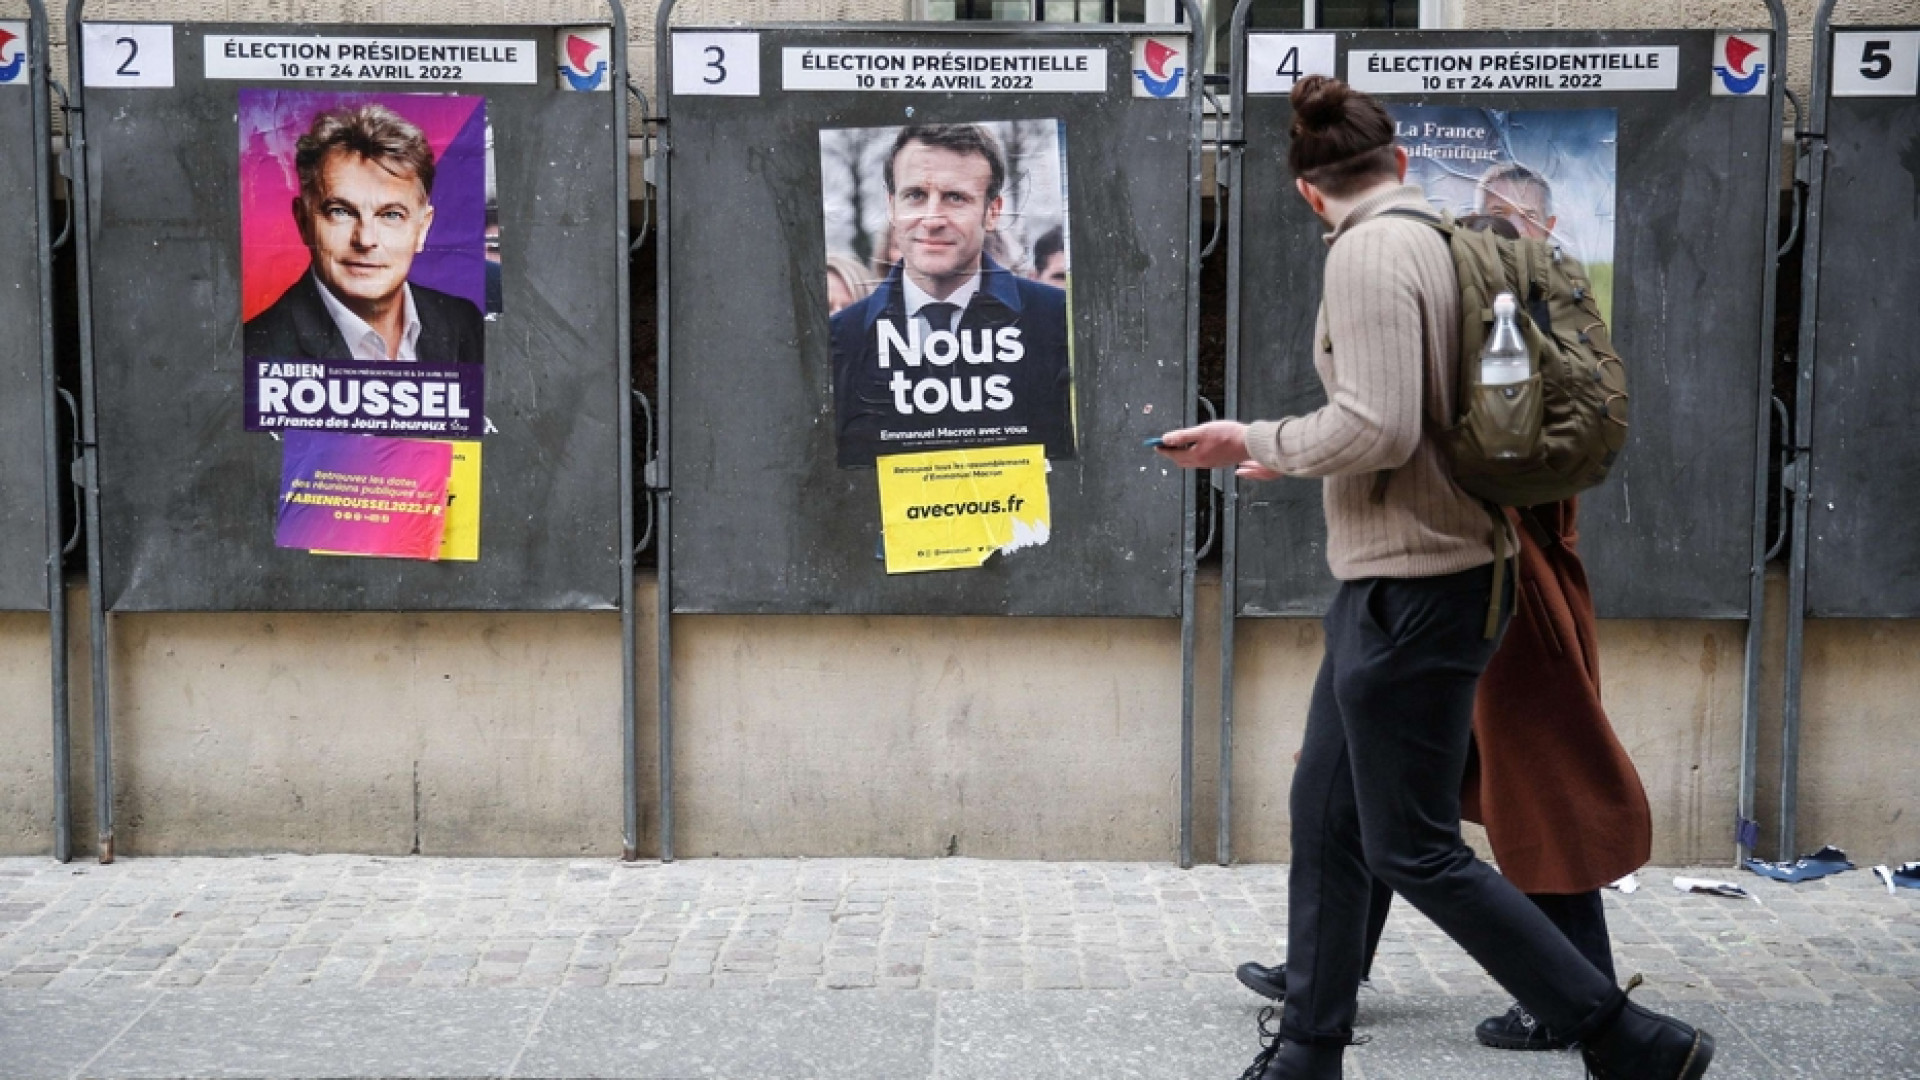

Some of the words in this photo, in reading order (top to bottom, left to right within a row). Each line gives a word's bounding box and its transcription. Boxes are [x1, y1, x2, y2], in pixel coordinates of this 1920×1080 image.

[115, 37, 141, 78] 2
[223, 39, 331, 59] ÉLECTION
[338, 41, 518, 63] PRÉSIDENTIELLE
[801, 50, 905, 71] ÉLECTION
[912, 51, 1088, 71] PRÉSIDENTIELLE
[1367, 53, 1473, 72] ÉLECTION
[1479, 51, 1660, 71] PRÉSIDENTIELLE
[1859, 40, 1892, 79] 5
[280, 63, 300, 77] 10
[305, 65, 325, 77] ET
[330, 64, 353, 78] 24
[357, 65, 414, 79] AVRIL
[419, 65, 463, 80] 2022
[702, 45, 727, 84] 3
[1276, 46, 1303, 83] 4
[855, 74, 875, 88] 10
[880, 77, 900, 88] ET
[904, 75, 927, 89] 24
[931, 75, 986, 89] AVRIL
[991, 75, 1034, 89] 2022
[1421, 75, 1441, 89] 10
[1446, 77, 1466, 89] ET
[1470, 75, 1494, 89] 24
[1498, 75, 1553, 89] AVRIL
[1559, 74, 1602, 88] 2022
[1394, 121, 1418, 136] La
[1423, 121, 1486, 138] France
[1406, 143, 1499, 162] uthentique
[876, 318, 1025, 368] Nous
[258, 362, 325, 378] FABIEN
[258, 377, 470, 418] ROUSSEL
[889, 370, 1014, 414] tous
[259, 415, 276, 427] La
[277, 416, 324, 428] France
[324, 418, 349, 429] des
[351, 417, 388, 430] Jours
[390, 418, 447, 431] heureux
[880, 428, 934, 441] Emmanuel
[937, 427, 976, 438] Macron
[978, 427, 1001, 436] avec
[1003, 425, 1028, 435] vous
[314, 470, 367, 483] Retrouvez
[369, 474, 384, 484] les
[386, 477, 417, 488] dates
[972, 470, 1003, 478] Macron
[291, 479, 311, 489] des
[312, 480, 359, 494] réunions
[360, 483, 415, 499] publiques
[285, 491, 442, 516] FABIENROUSSEL2022.FR
[906, 494, 1025, 520] avecvous.fr
